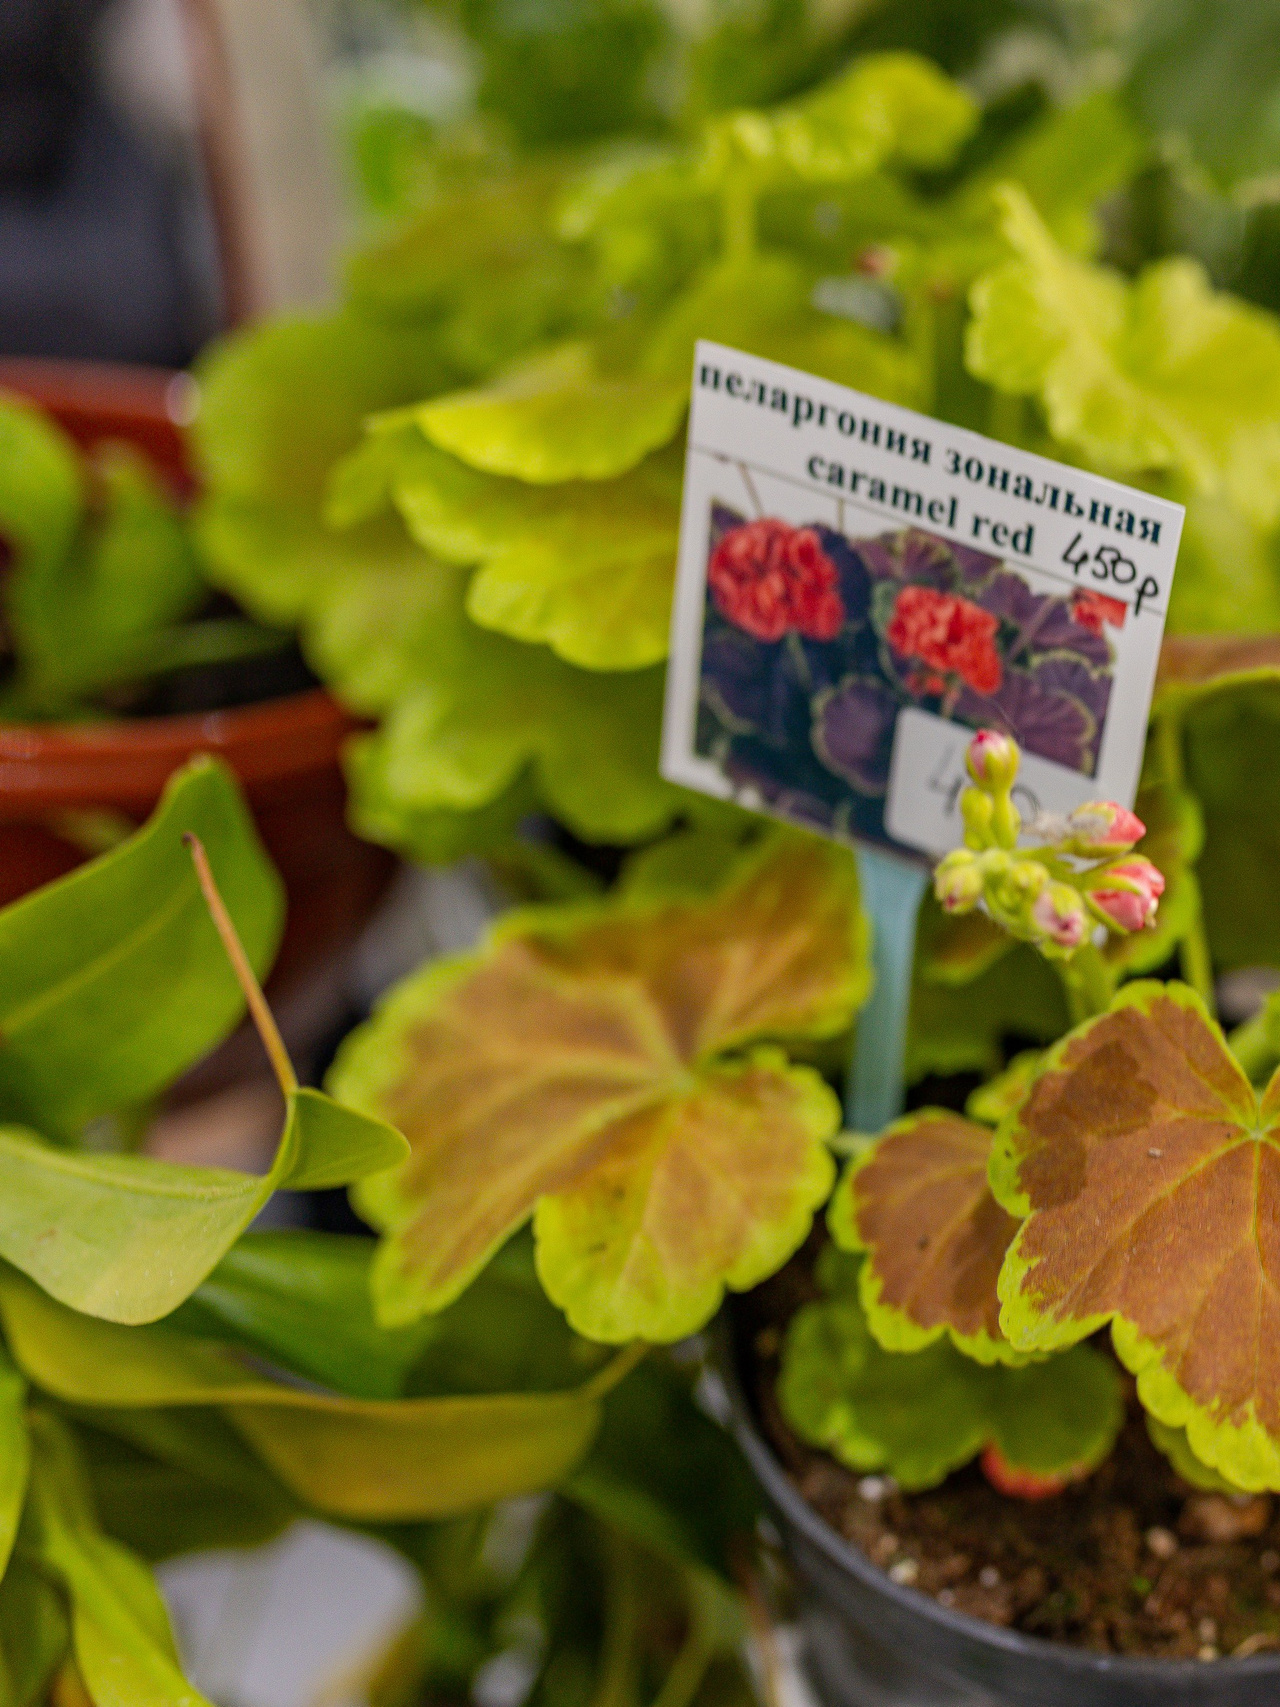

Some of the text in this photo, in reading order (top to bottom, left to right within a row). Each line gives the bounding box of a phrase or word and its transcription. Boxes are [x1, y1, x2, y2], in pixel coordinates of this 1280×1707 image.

[700, 364, 1163, 545] пеларгония зональная
[807, 453, 1035, 556] caramel red
